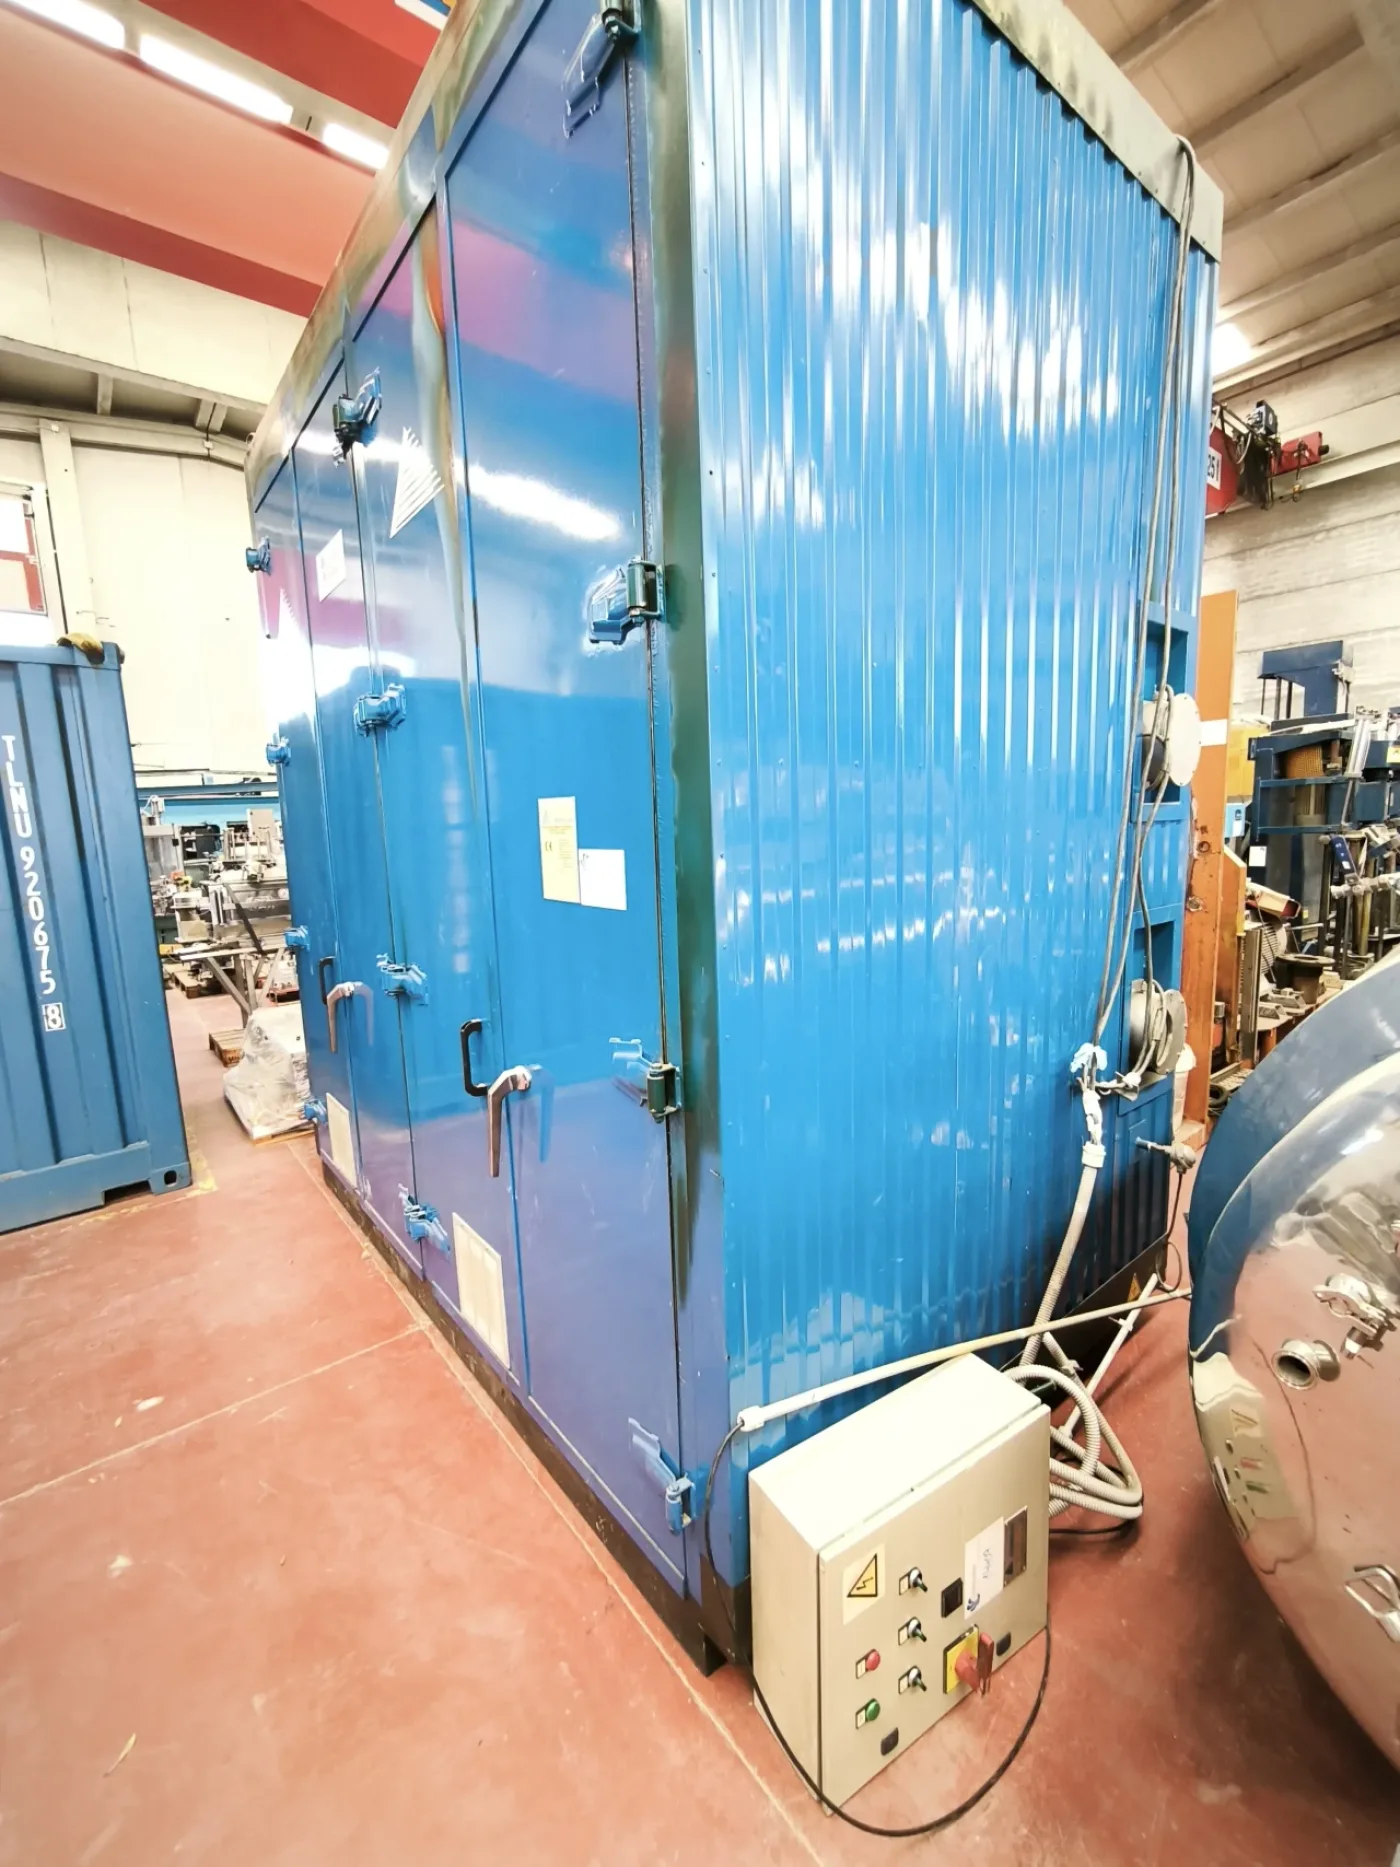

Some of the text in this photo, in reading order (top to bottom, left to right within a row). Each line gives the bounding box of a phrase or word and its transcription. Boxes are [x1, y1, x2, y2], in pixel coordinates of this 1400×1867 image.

[1, 735, 63, 1030] TLNU 920675 8
